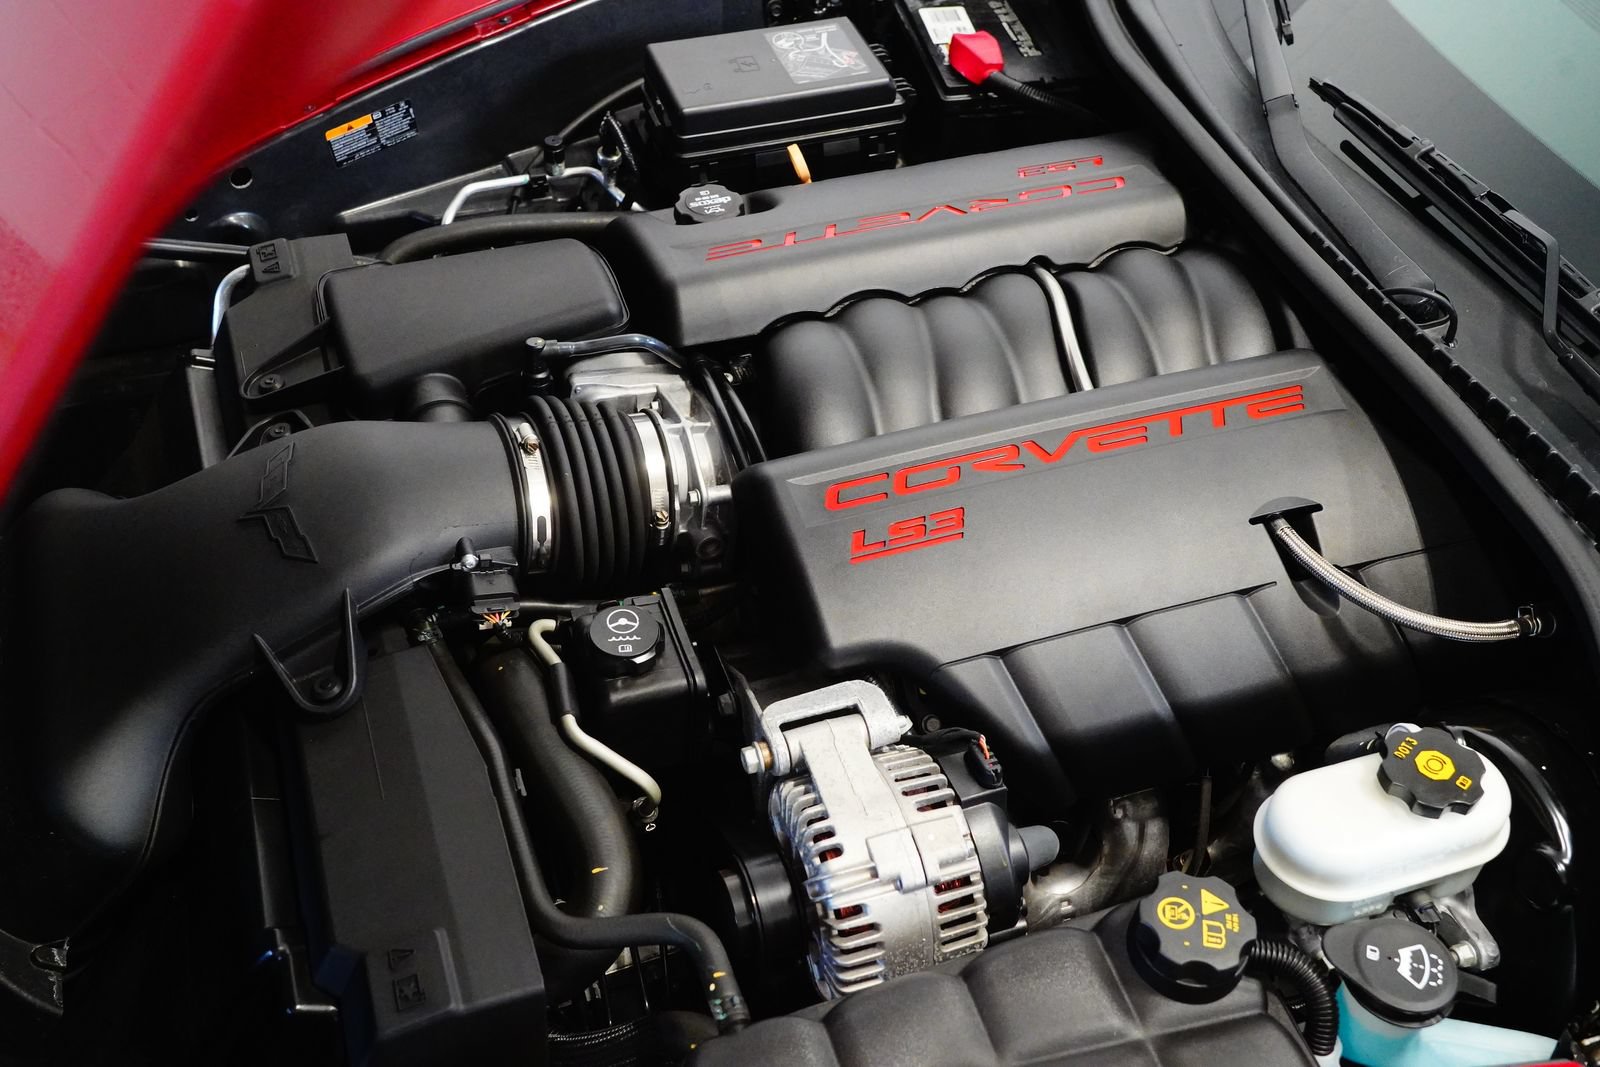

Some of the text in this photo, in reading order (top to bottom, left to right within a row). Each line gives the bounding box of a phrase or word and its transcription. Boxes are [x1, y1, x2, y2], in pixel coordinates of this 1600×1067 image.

[1018, 155, 1103, 177] LS3
[705, 176, 1126, 261] CORVETTE
[824, 384, 1305, 511] CORVETTE
[850, 506, 965, 557] LS3
[1394, 737, 1418, 759] DOT 3
